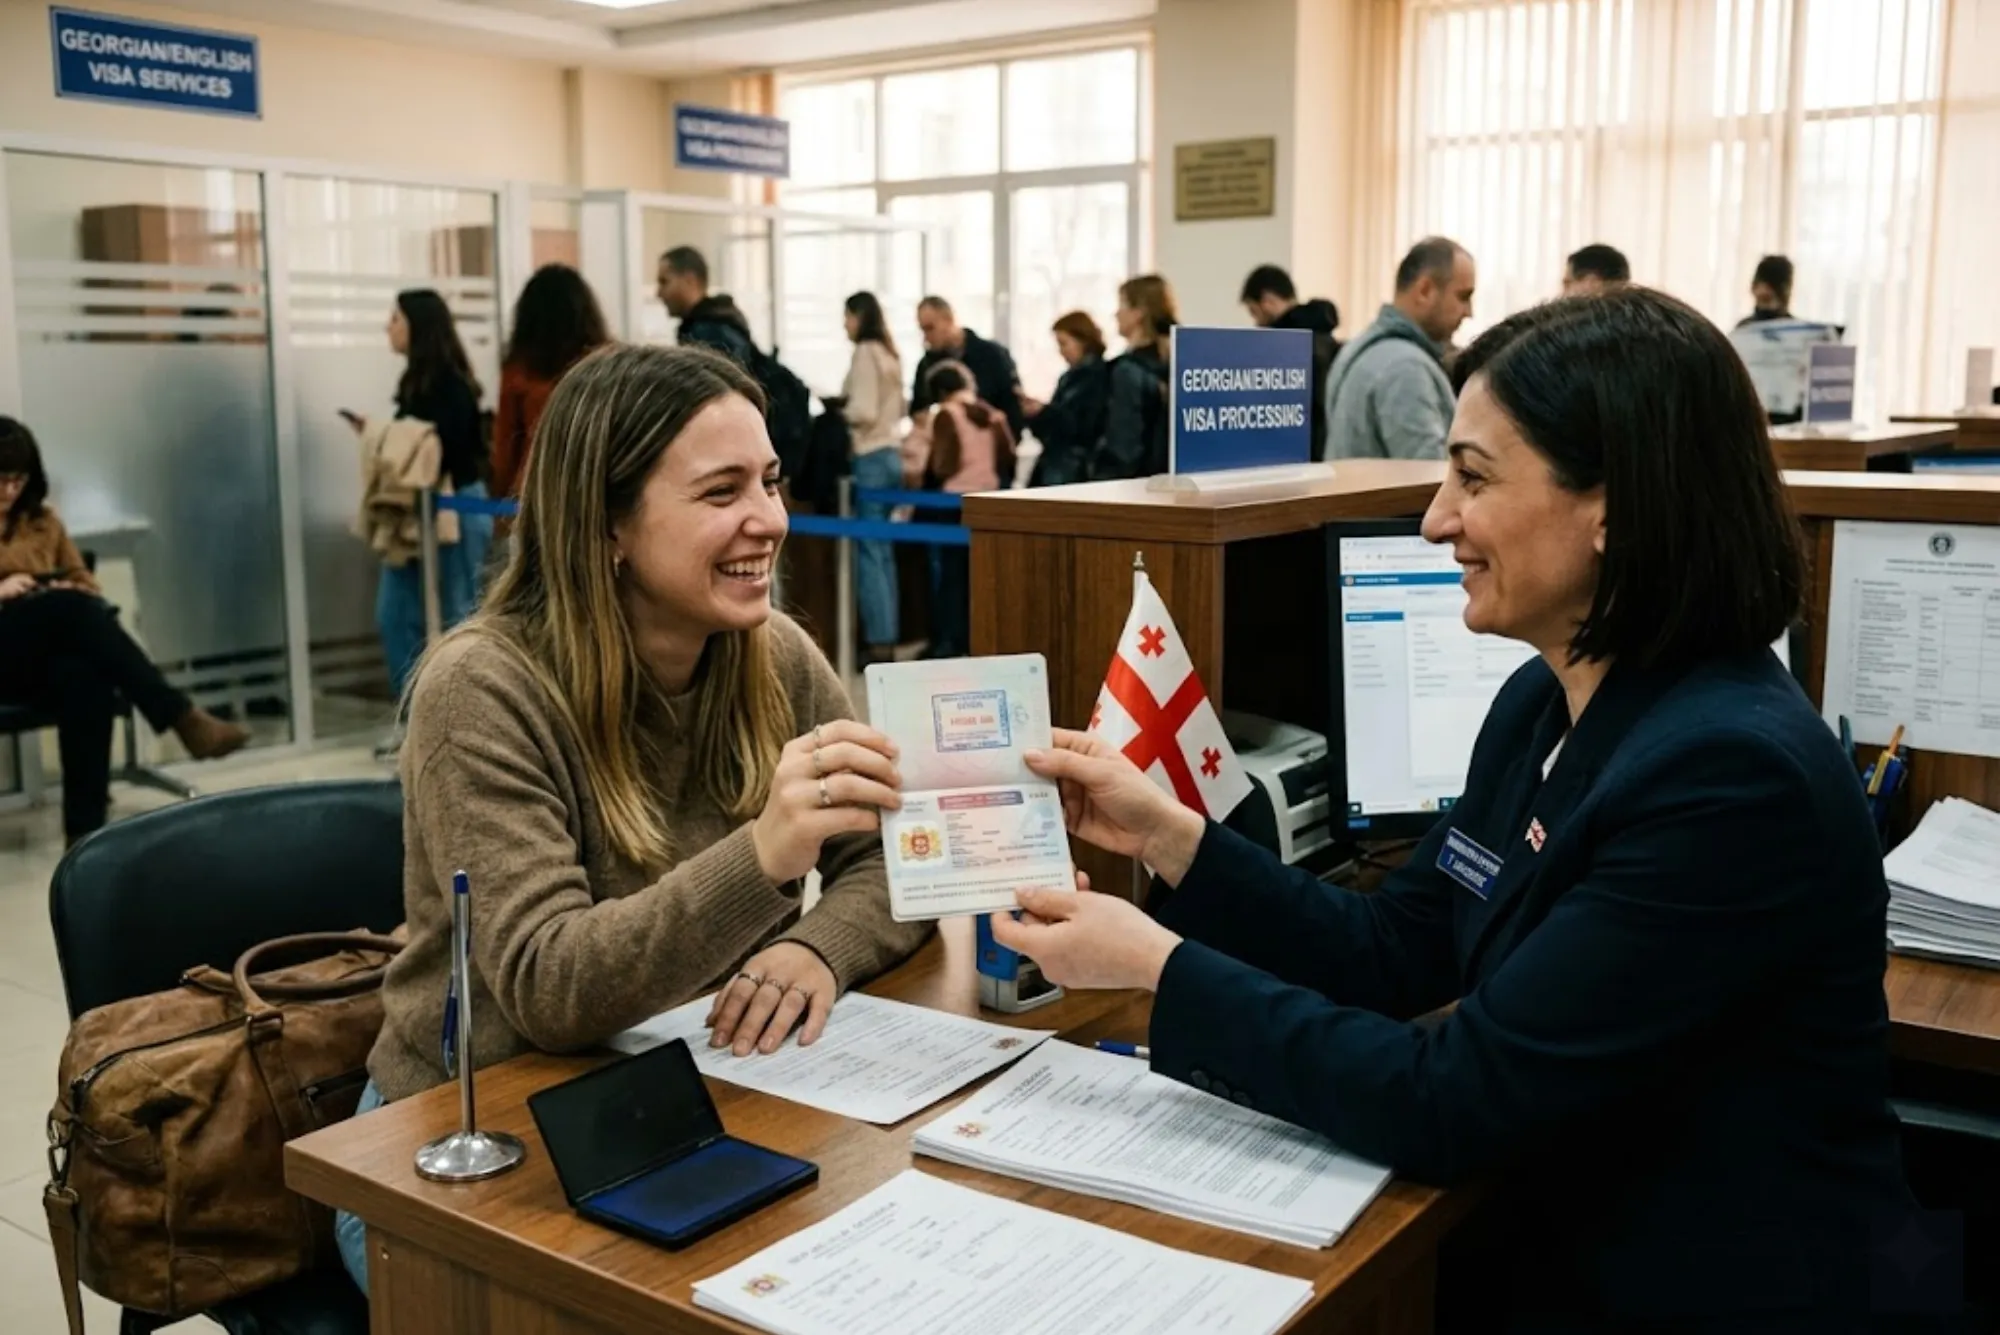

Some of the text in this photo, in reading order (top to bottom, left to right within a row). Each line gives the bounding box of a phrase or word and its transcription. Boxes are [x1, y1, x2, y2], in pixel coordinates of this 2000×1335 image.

[61, 28, 252, 73] GEORGIAN/ENGLISH
[88, 61, 233, 99] VISA SERVICES
[1182, 368, 1307, 392] GEORGIAN/ENGLISH
[1182, 403, 1304, 432] VISA PROCESSING
